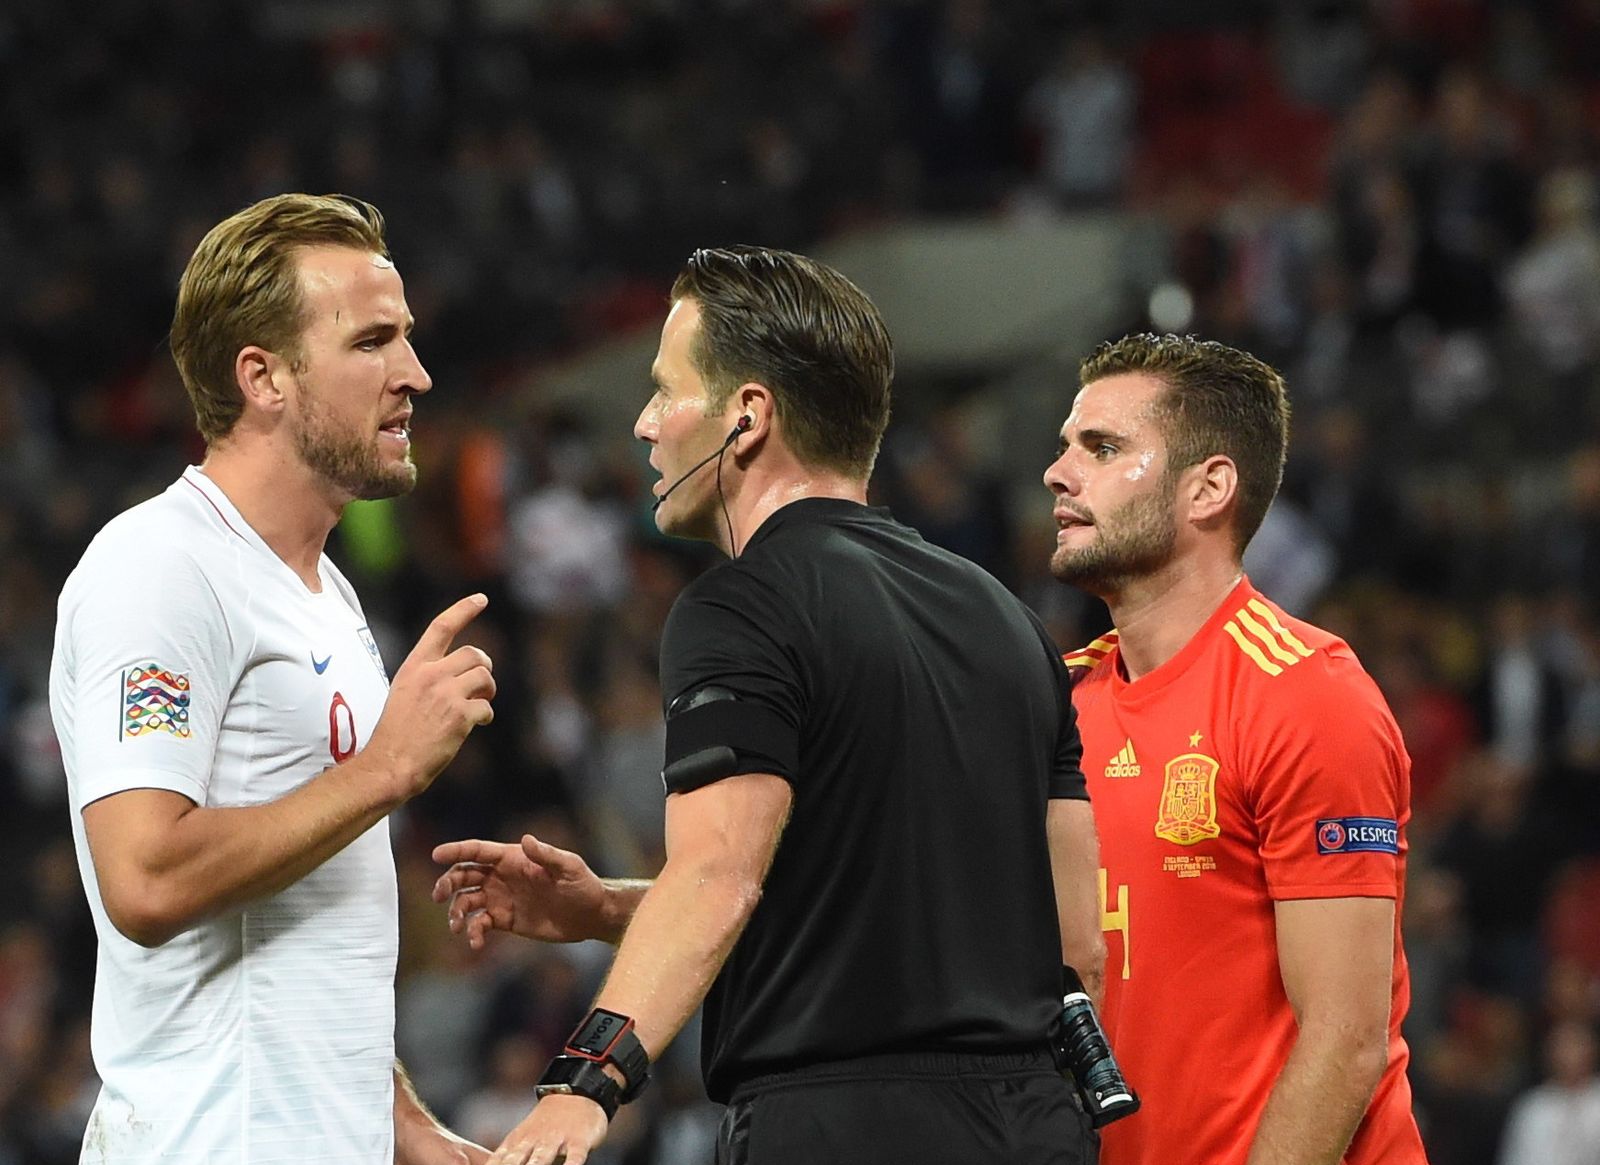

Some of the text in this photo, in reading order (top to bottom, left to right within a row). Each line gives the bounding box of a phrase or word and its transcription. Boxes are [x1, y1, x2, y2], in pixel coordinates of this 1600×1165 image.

[1104, 764, 1141, 778] adidas
[1348, 826, 1398, 845] RESPECT
[1098, 868, 1130, 980] 4
